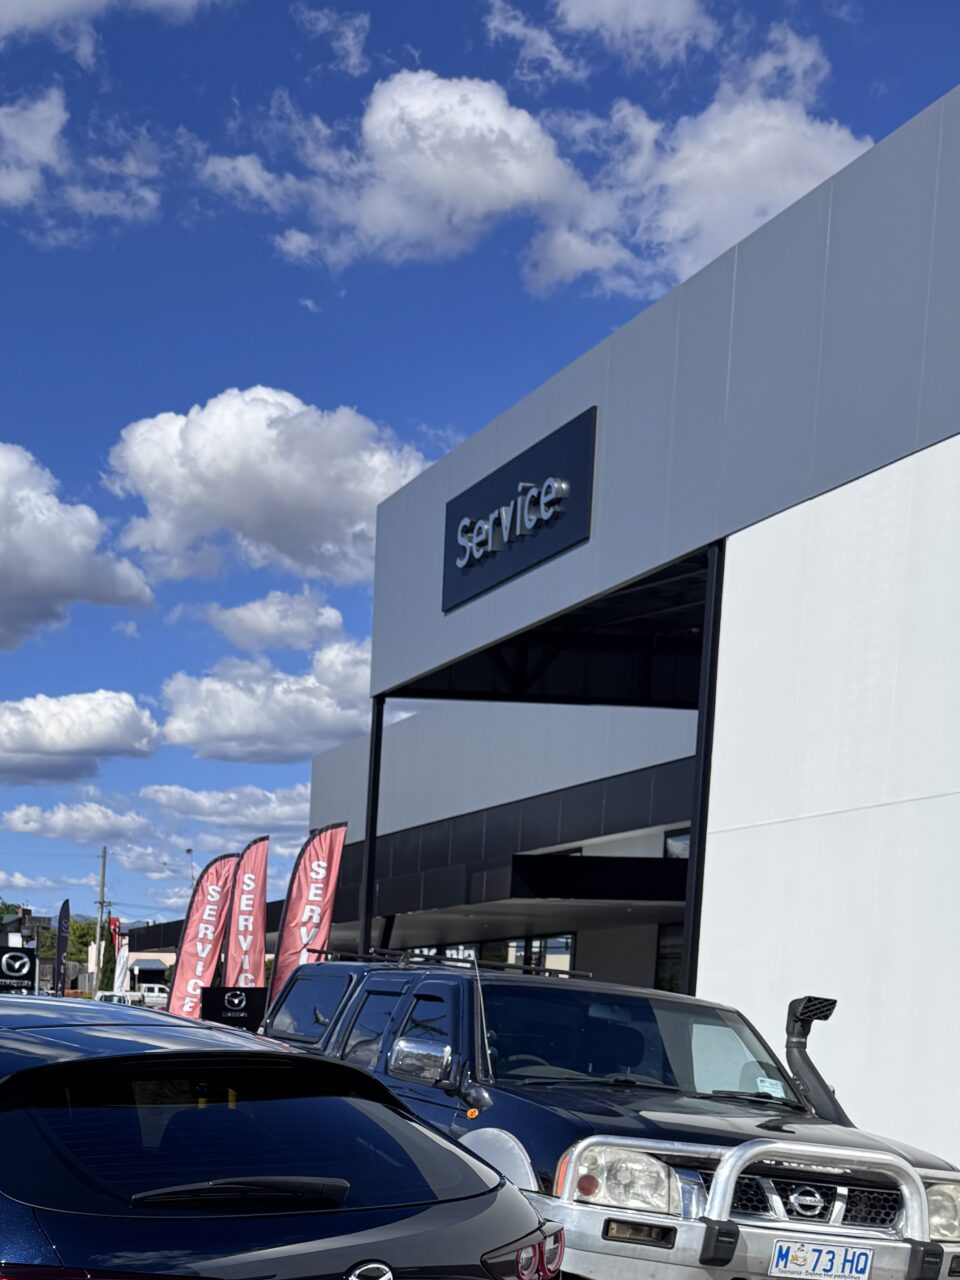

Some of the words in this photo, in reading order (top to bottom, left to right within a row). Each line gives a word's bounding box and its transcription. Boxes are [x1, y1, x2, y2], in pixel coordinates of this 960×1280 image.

[455, 477, 558, 568] Service
[182, 885, 222, 1012] SERVICE
[775, 1245, 791, 1269] M
[811, 1248, 835, 1273] 73
[841, 1248, 869, 1275] HQ
